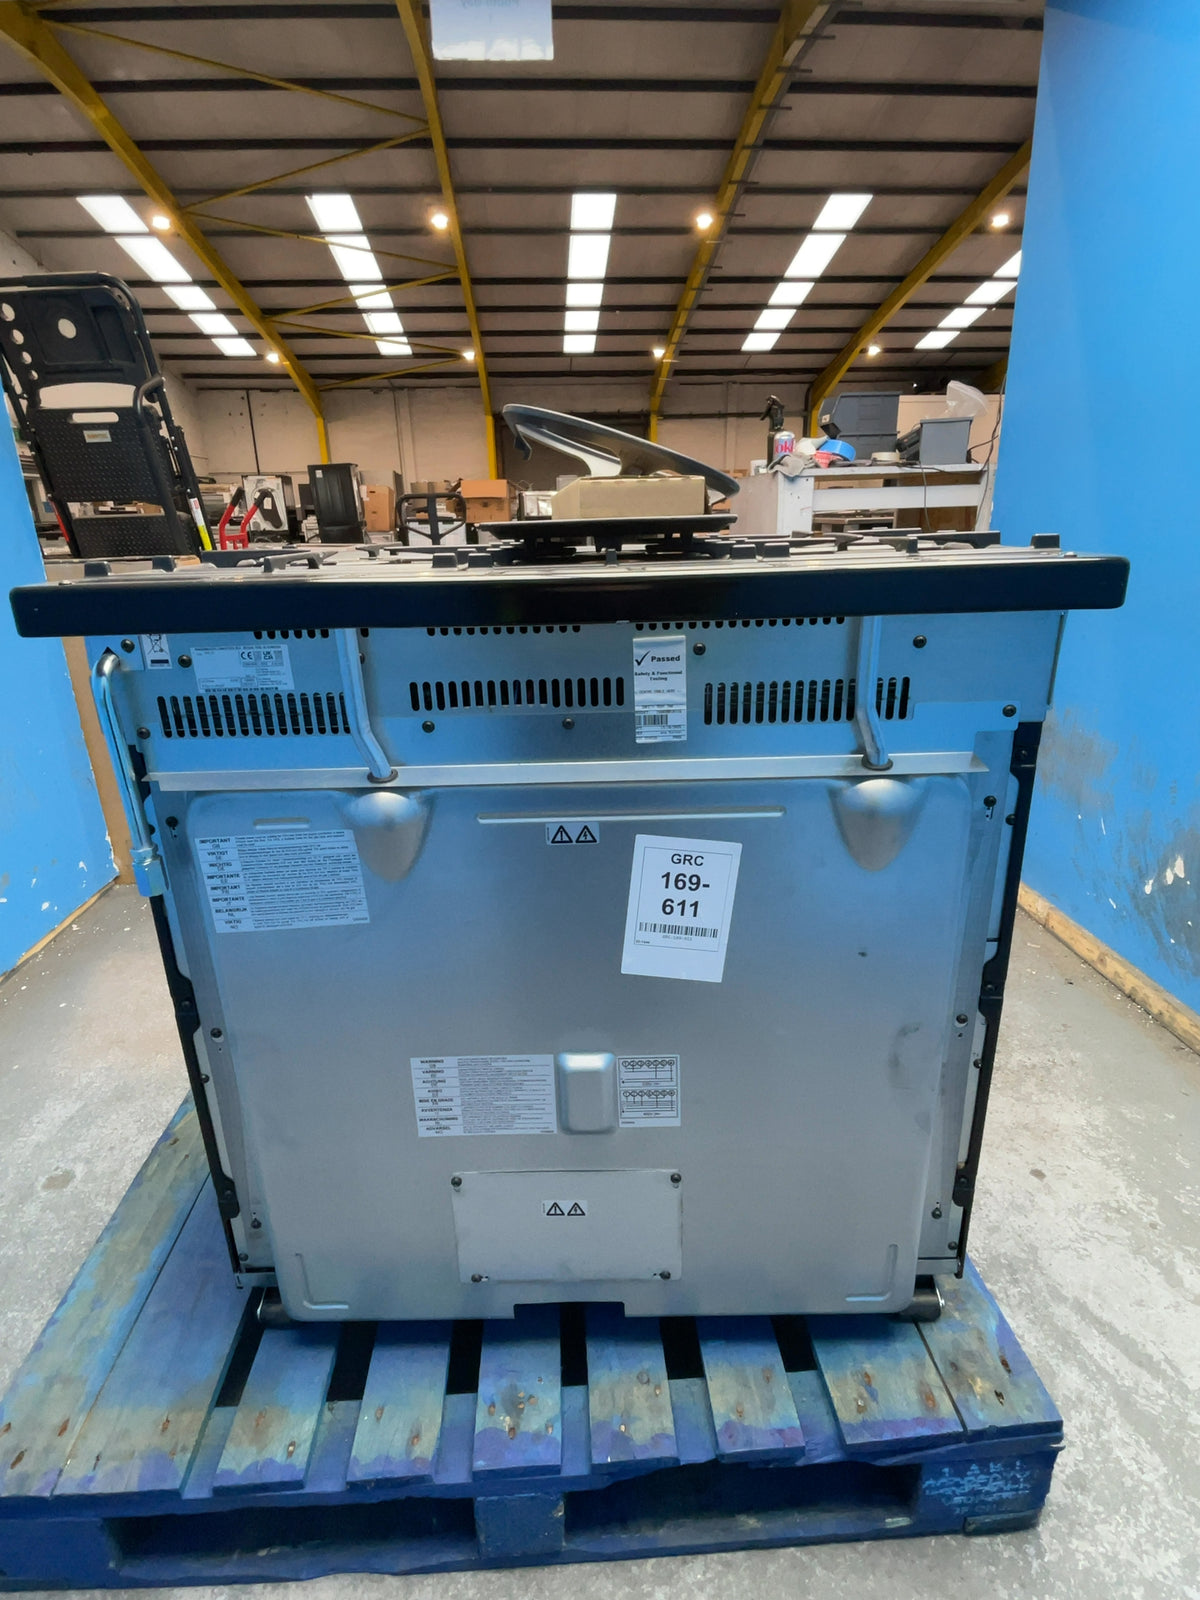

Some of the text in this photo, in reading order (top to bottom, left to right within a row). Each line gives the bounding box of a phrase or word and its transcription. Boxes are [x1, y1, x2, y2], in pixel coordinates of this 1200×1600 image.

[671, 853, 704, 867] GRC
[661, 871, 710, 892] 169-
[661, 898, 699, 917] 611
